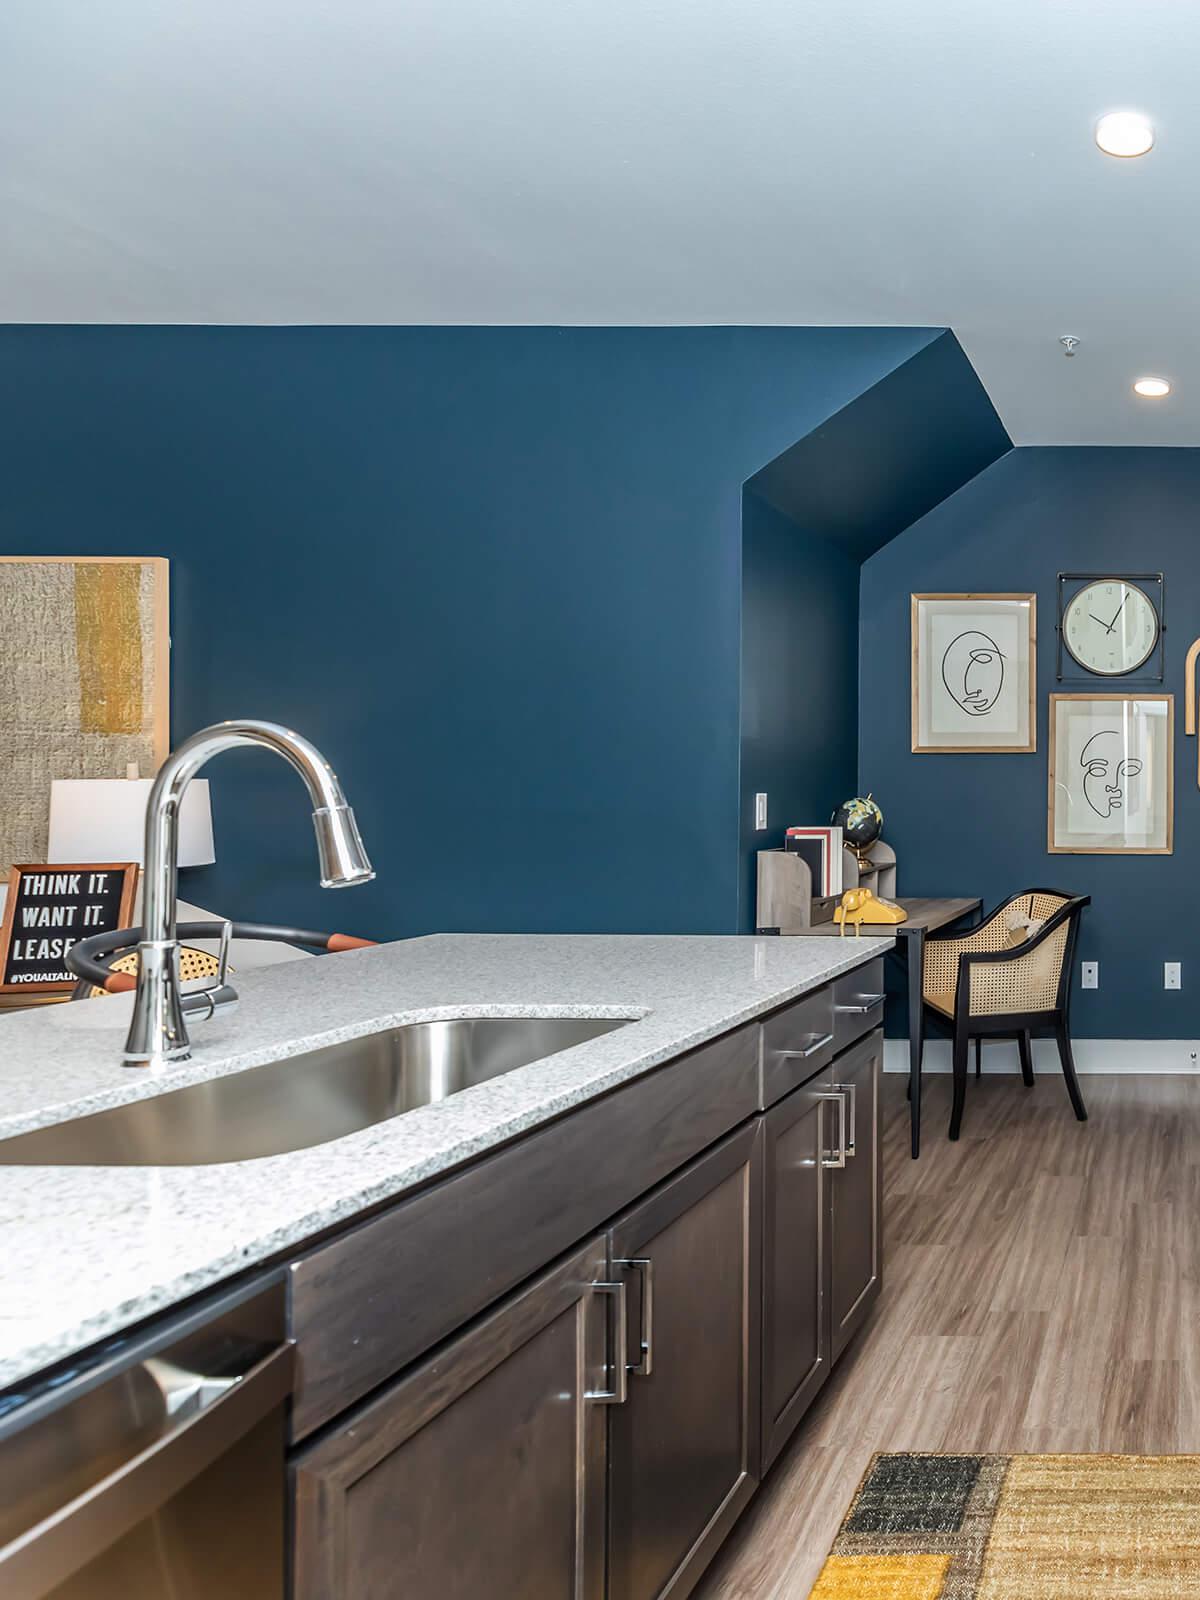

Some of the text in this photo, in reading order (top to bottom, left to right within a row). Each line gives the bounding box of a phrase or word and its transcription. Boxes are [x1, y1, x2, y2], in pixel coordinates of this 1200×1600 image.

[1105, 587, 1113, 595] 12
[23, 874, 109, 895] THINK IT.
[22, 905, 105, 927] WANT IT.
